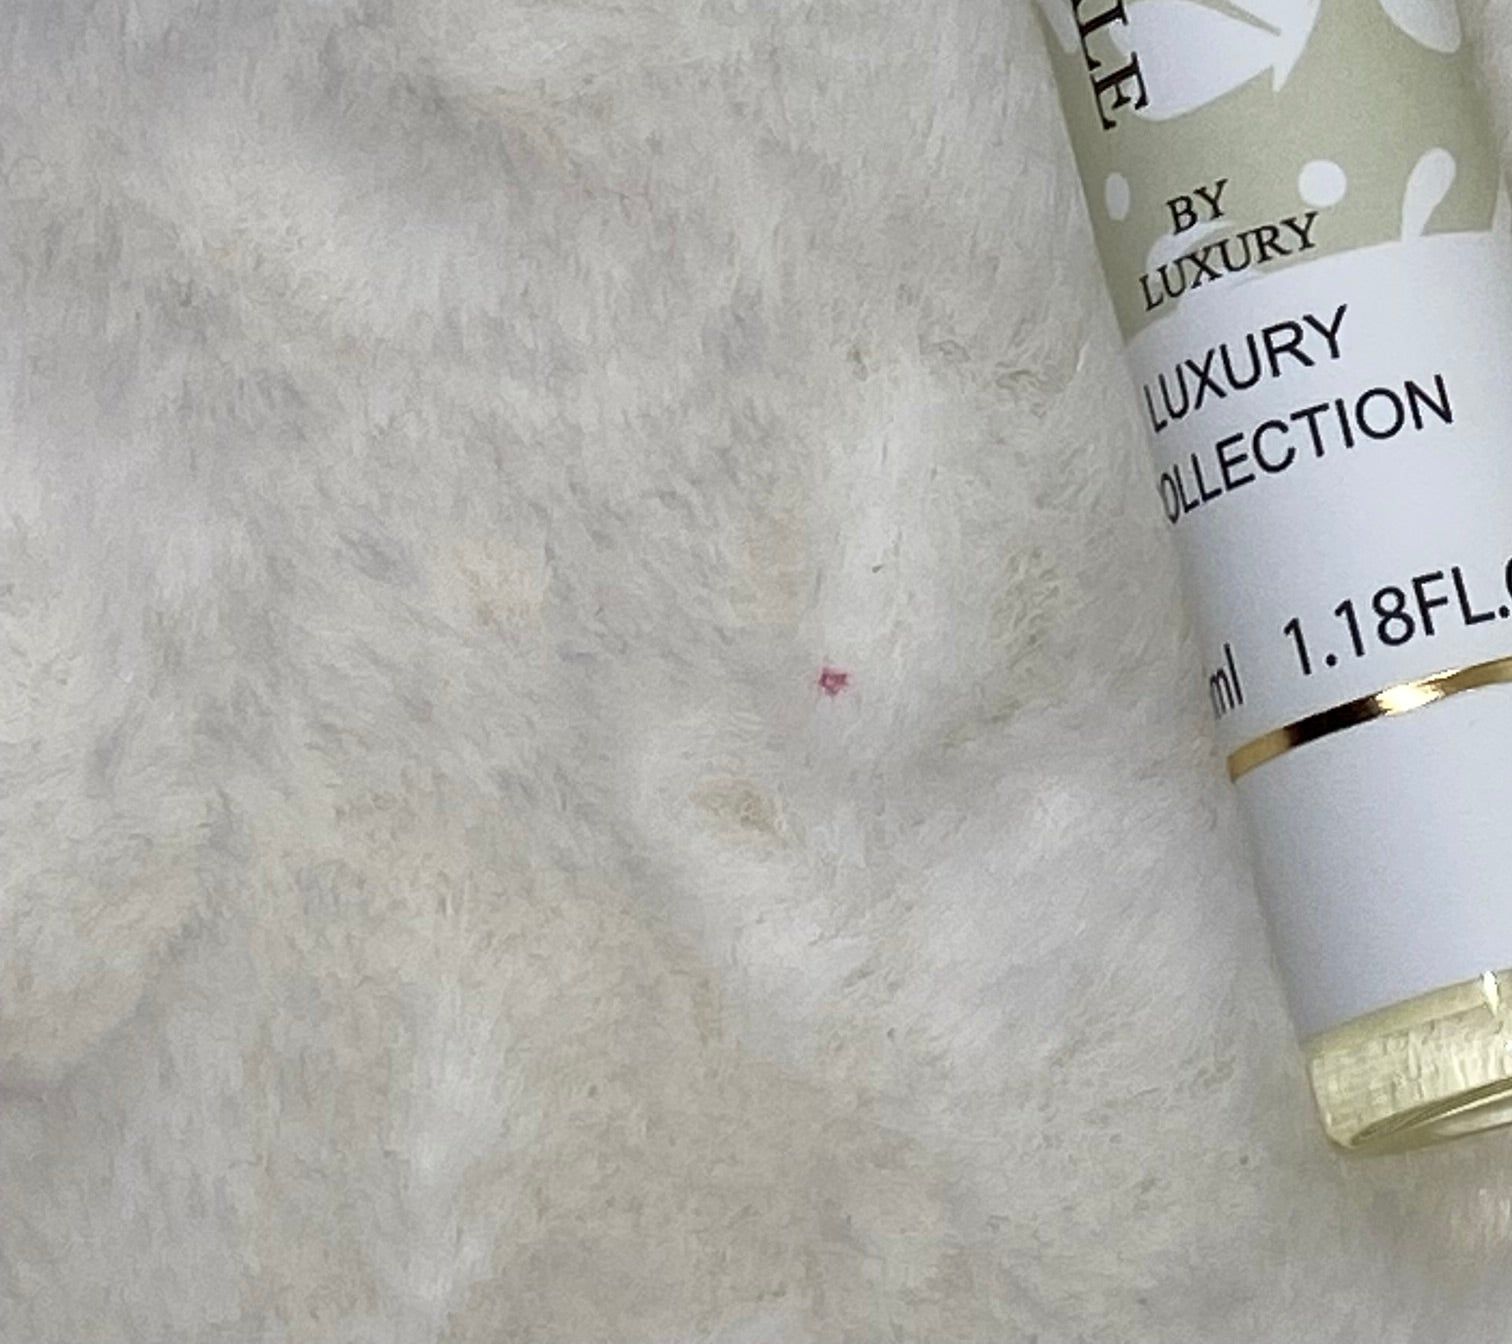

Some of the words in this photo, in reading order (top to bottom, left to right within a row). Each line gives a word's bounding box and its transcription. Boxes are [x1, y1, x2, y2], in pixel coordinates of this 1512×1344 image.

[1138, 210, 1321, 311] LUXURY
[1166, 178, 1230, 236] BY
[1143, 303, 1348, 433] LUXURY
[1157, 373, 1455, 525] OLLECTION
